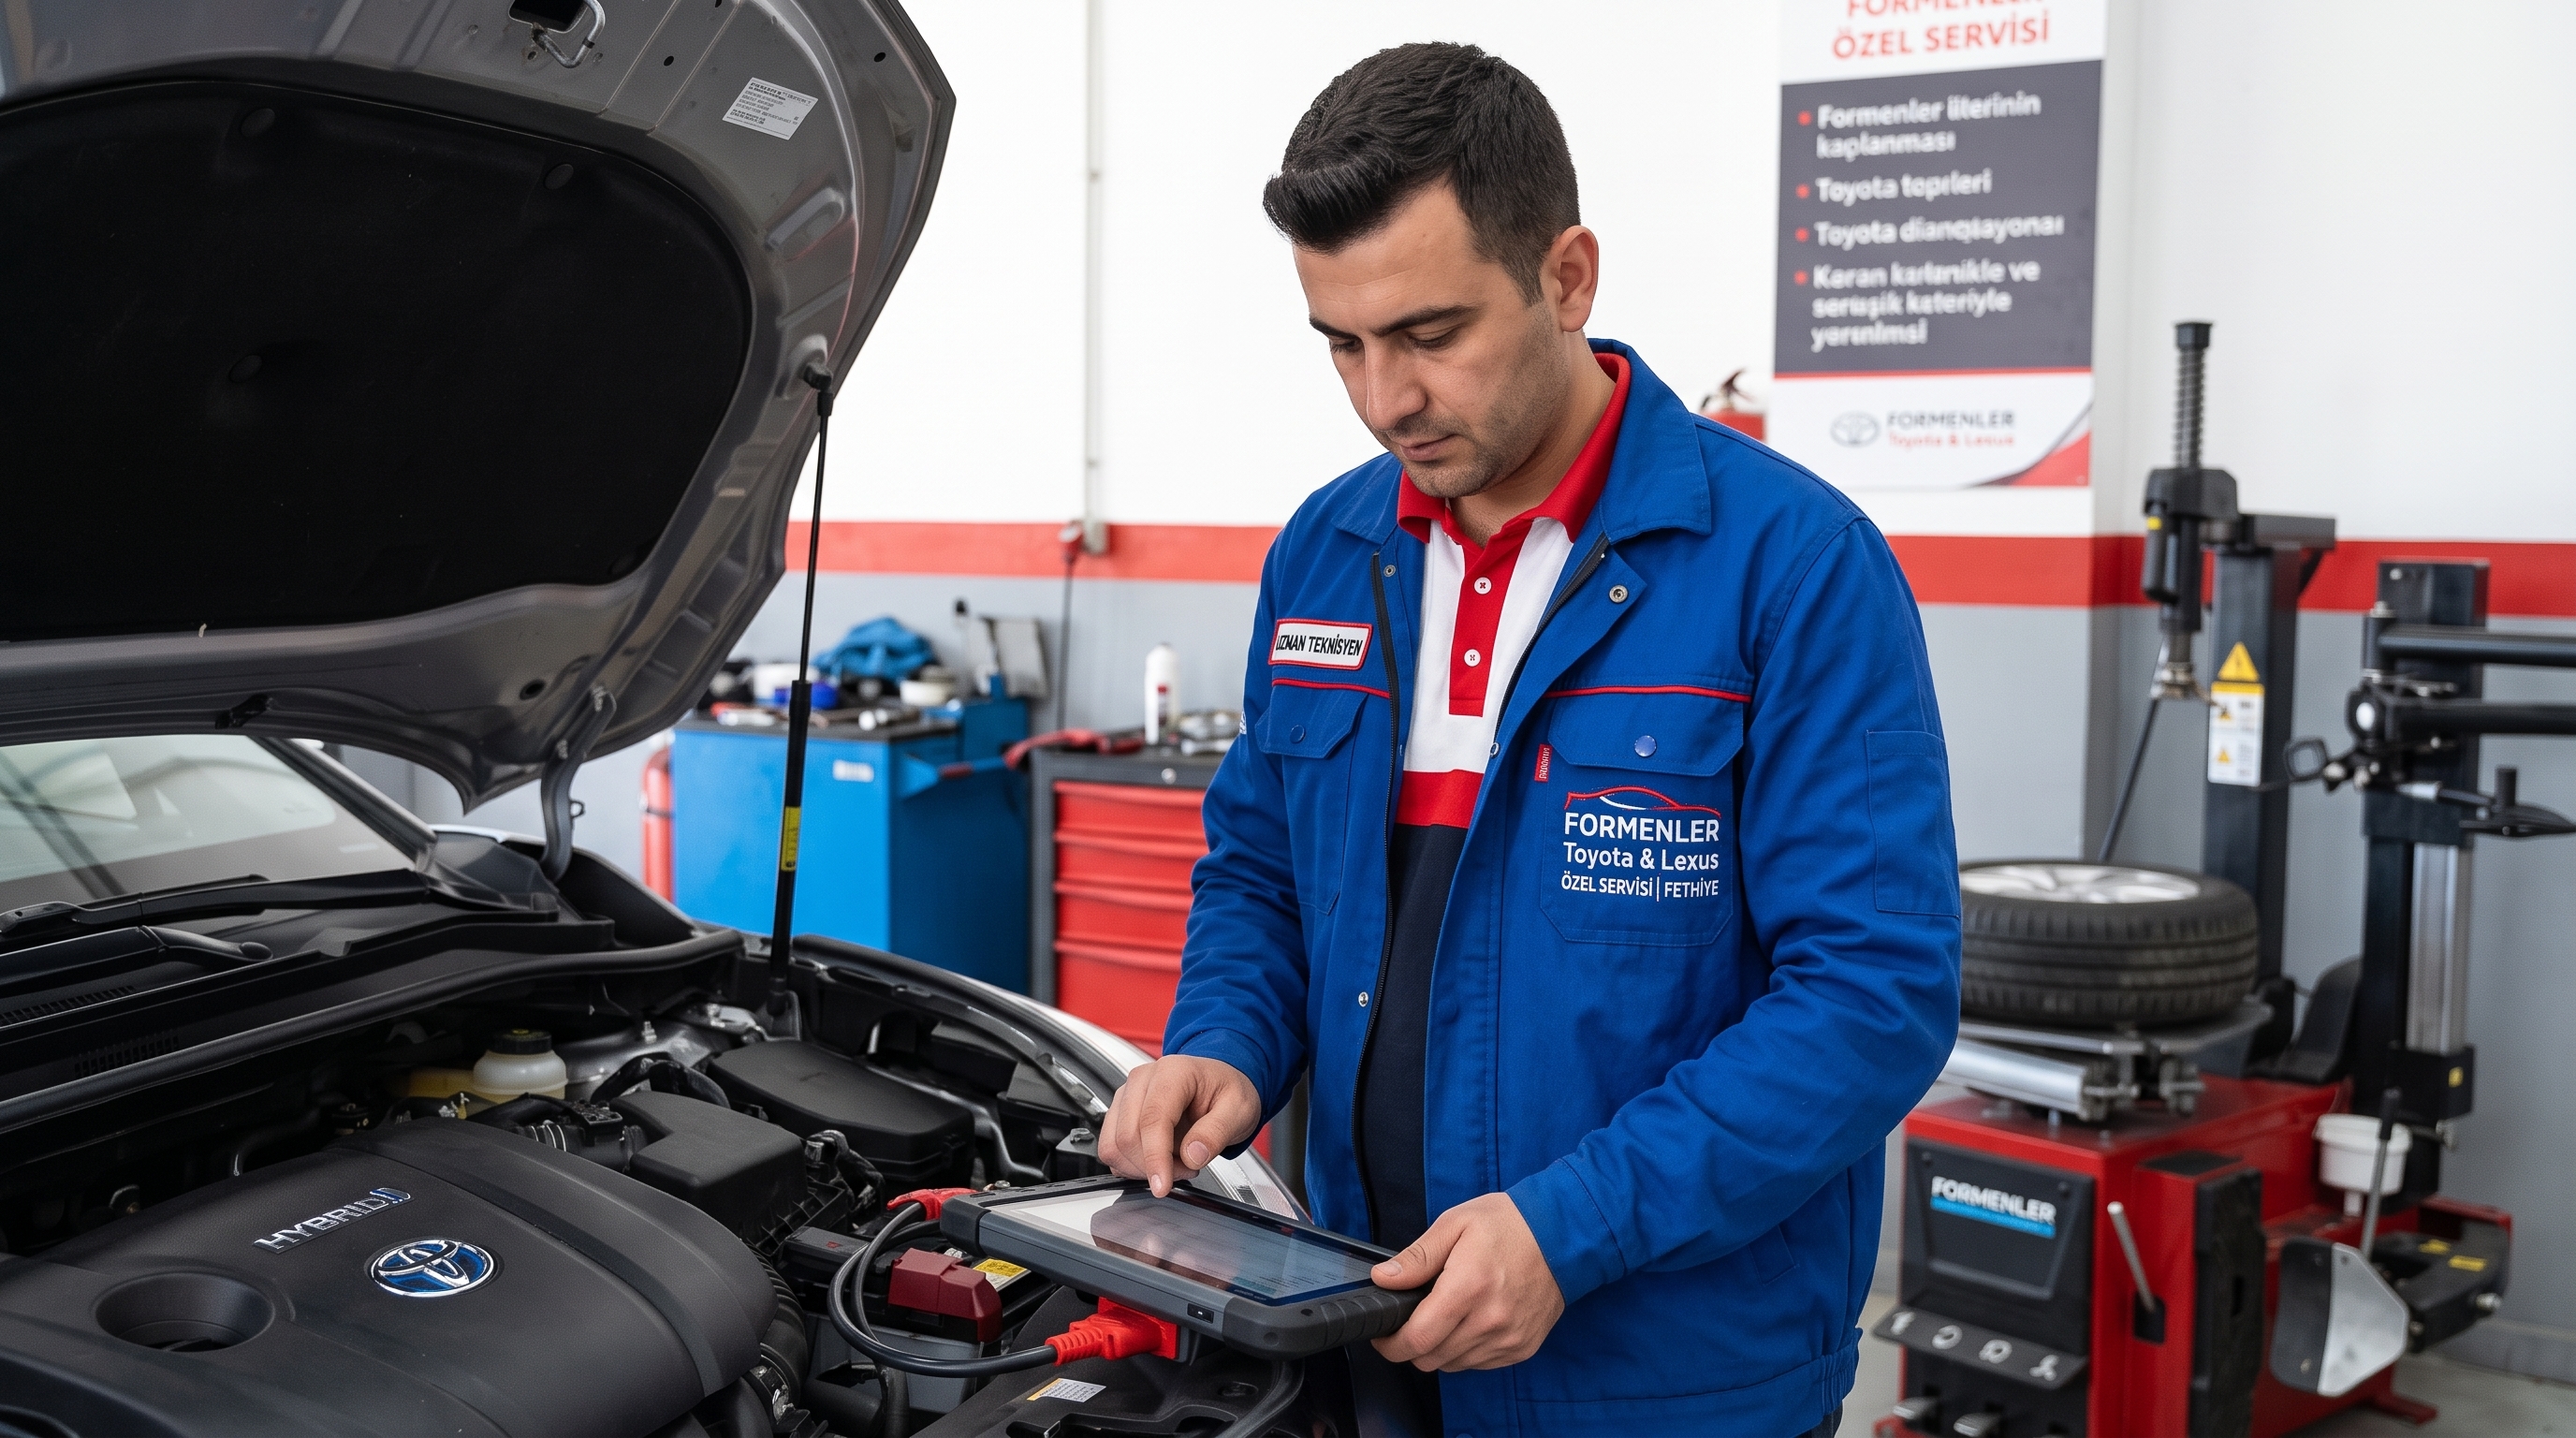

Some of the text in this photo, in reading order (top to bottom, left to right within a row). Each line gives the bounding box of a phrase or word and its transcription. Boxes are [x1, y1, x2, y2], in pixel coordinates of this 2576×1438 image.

[1833, 9, 2050, 59] ÖZEL SERVİSİ
[1818, 97, 1944, 129] Formenler
[1815, 175, 1898, 206] Toyota
[1814, 219, 1897, 251] Toyota
[1886, 410, 2015, 430] FORMENLER
[1309, 634, 1363, 656] TEKNİSYEN
[1564, 812, 1720, 843] FORMENLER
[1563, 842, 1719, 871] Toyota & Lexus
[1561, 871, 1596, 892] ÖZEL
[1599, 875, 1653, 896] SERVİSİ
[1664, 877, 1719, 898] FETHİYE
[1931, 1175, 2056, 1225] FORMENLER
[254, 1197, 389, 1250] HYBRID
